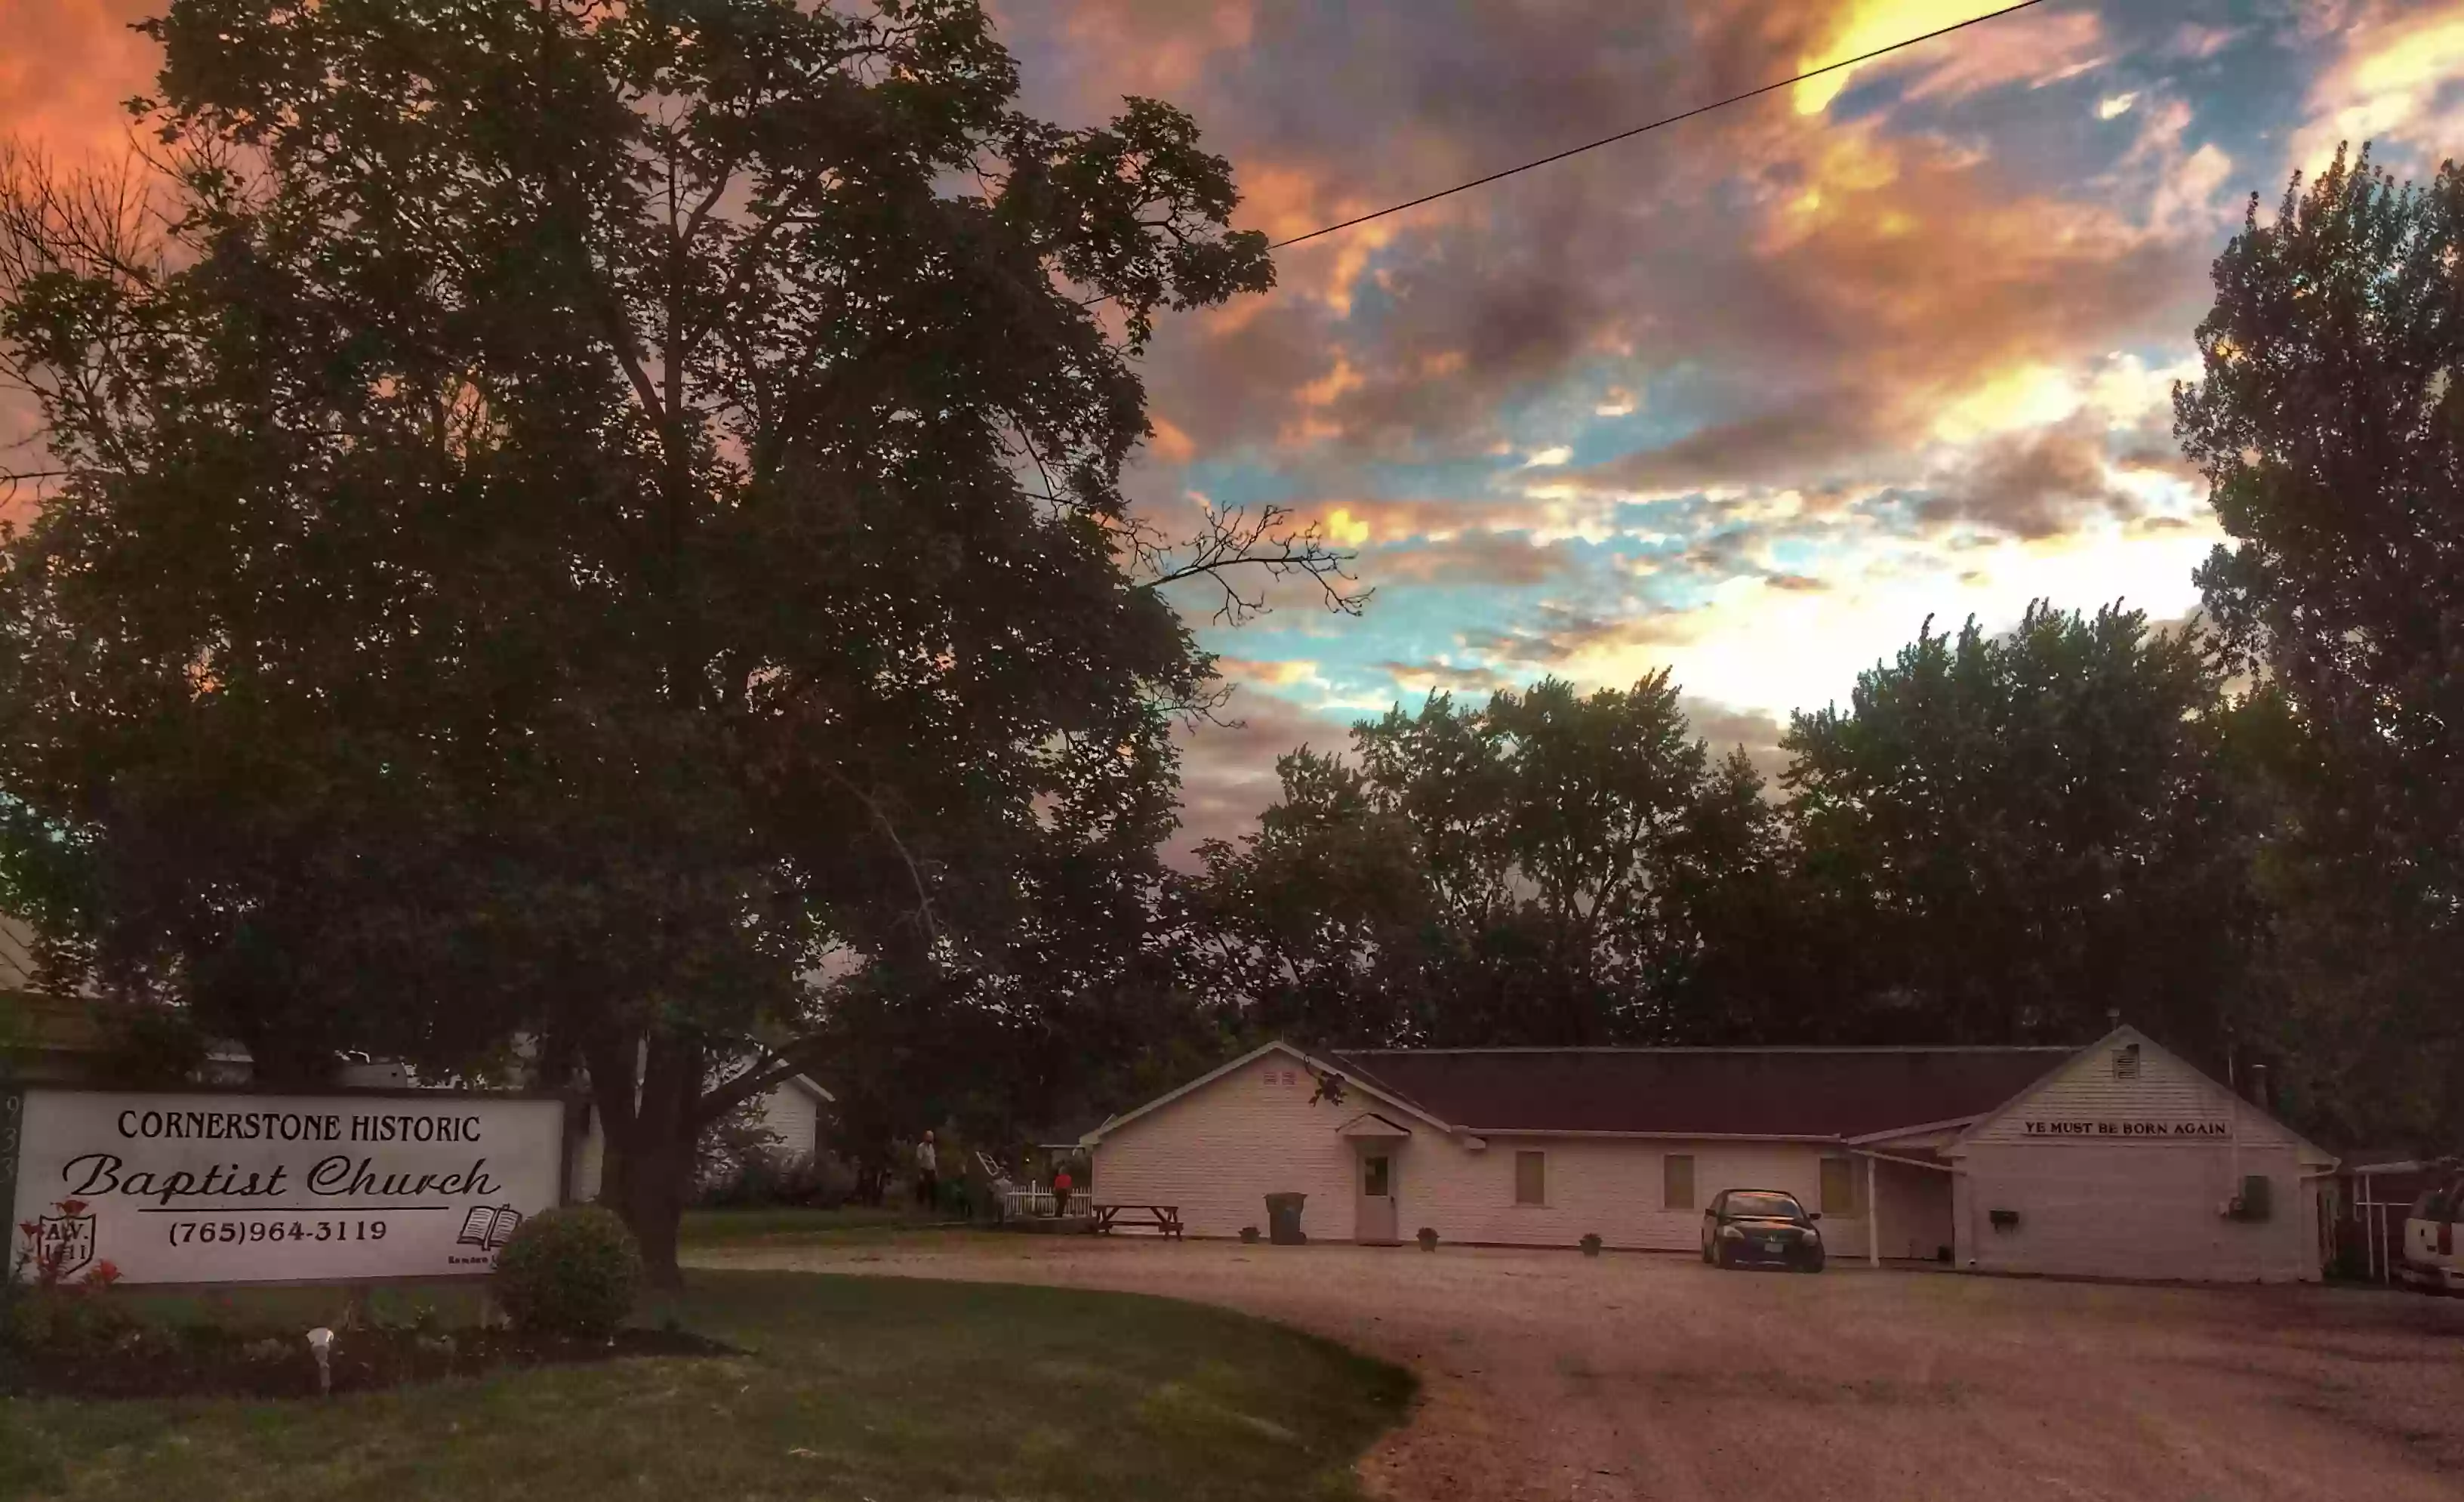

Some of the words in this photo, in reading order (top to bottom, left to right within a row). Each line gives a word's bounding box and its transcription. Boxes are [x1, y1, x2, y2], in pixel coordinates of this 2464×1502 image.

[118, 1110, 341, 1141] CORNERSTONE
[350, 1115, 481, 1142] HISTORIC
[2025, 1122, 2046, 1133] YE
[2050, 1122, 2093, 1133] MUST
[2099, 1123, 2118, 1134] BE
[2124, 1123, 2167, 1134] BORN
[2173, 1123, 2225, 1134] AGAIN
[63, 1153, 288, 1206] Baptist
[306, 1155, 501, 1195] Church
[169, 1220, 387, 1247] (765)964-3119
[45, 1244, 86, 1261] 111
